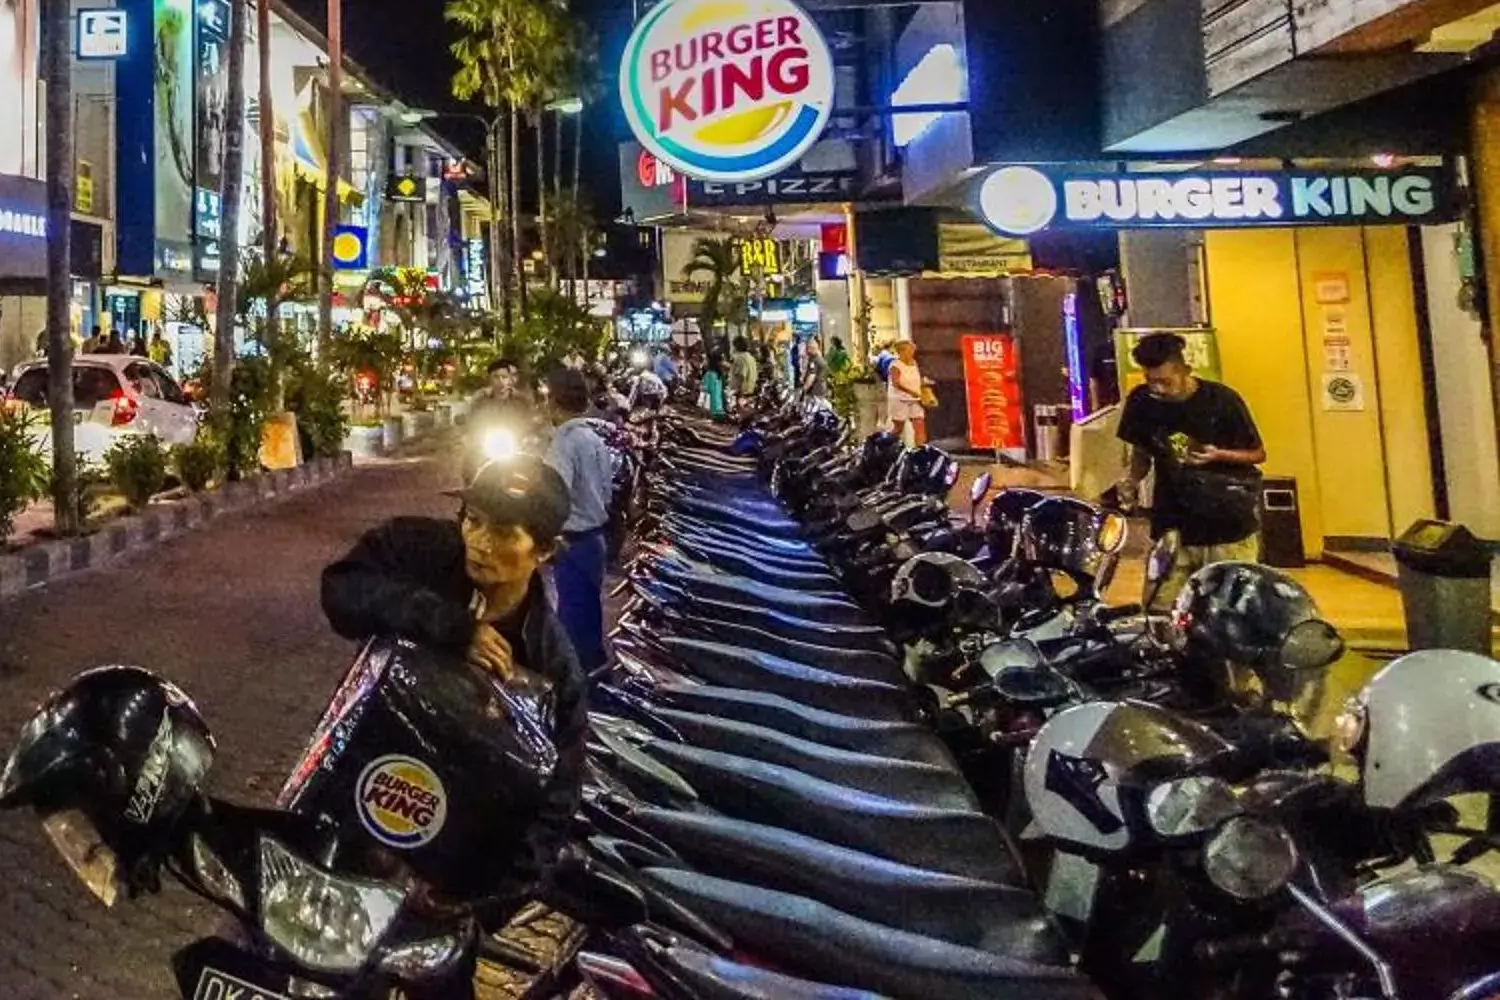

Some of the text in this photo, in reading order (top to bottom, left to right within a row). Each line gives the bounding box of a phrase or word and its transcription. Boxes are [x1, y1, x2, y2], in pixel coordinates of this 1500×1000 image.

[651, 15, 802, 83] BURGER
[659, 47, 810, 133] KING
[1064, 175, 1435, 221] BURGER KING
[364, 787, 435, 827] KING
[372, 771, 439, 812] BURGER
